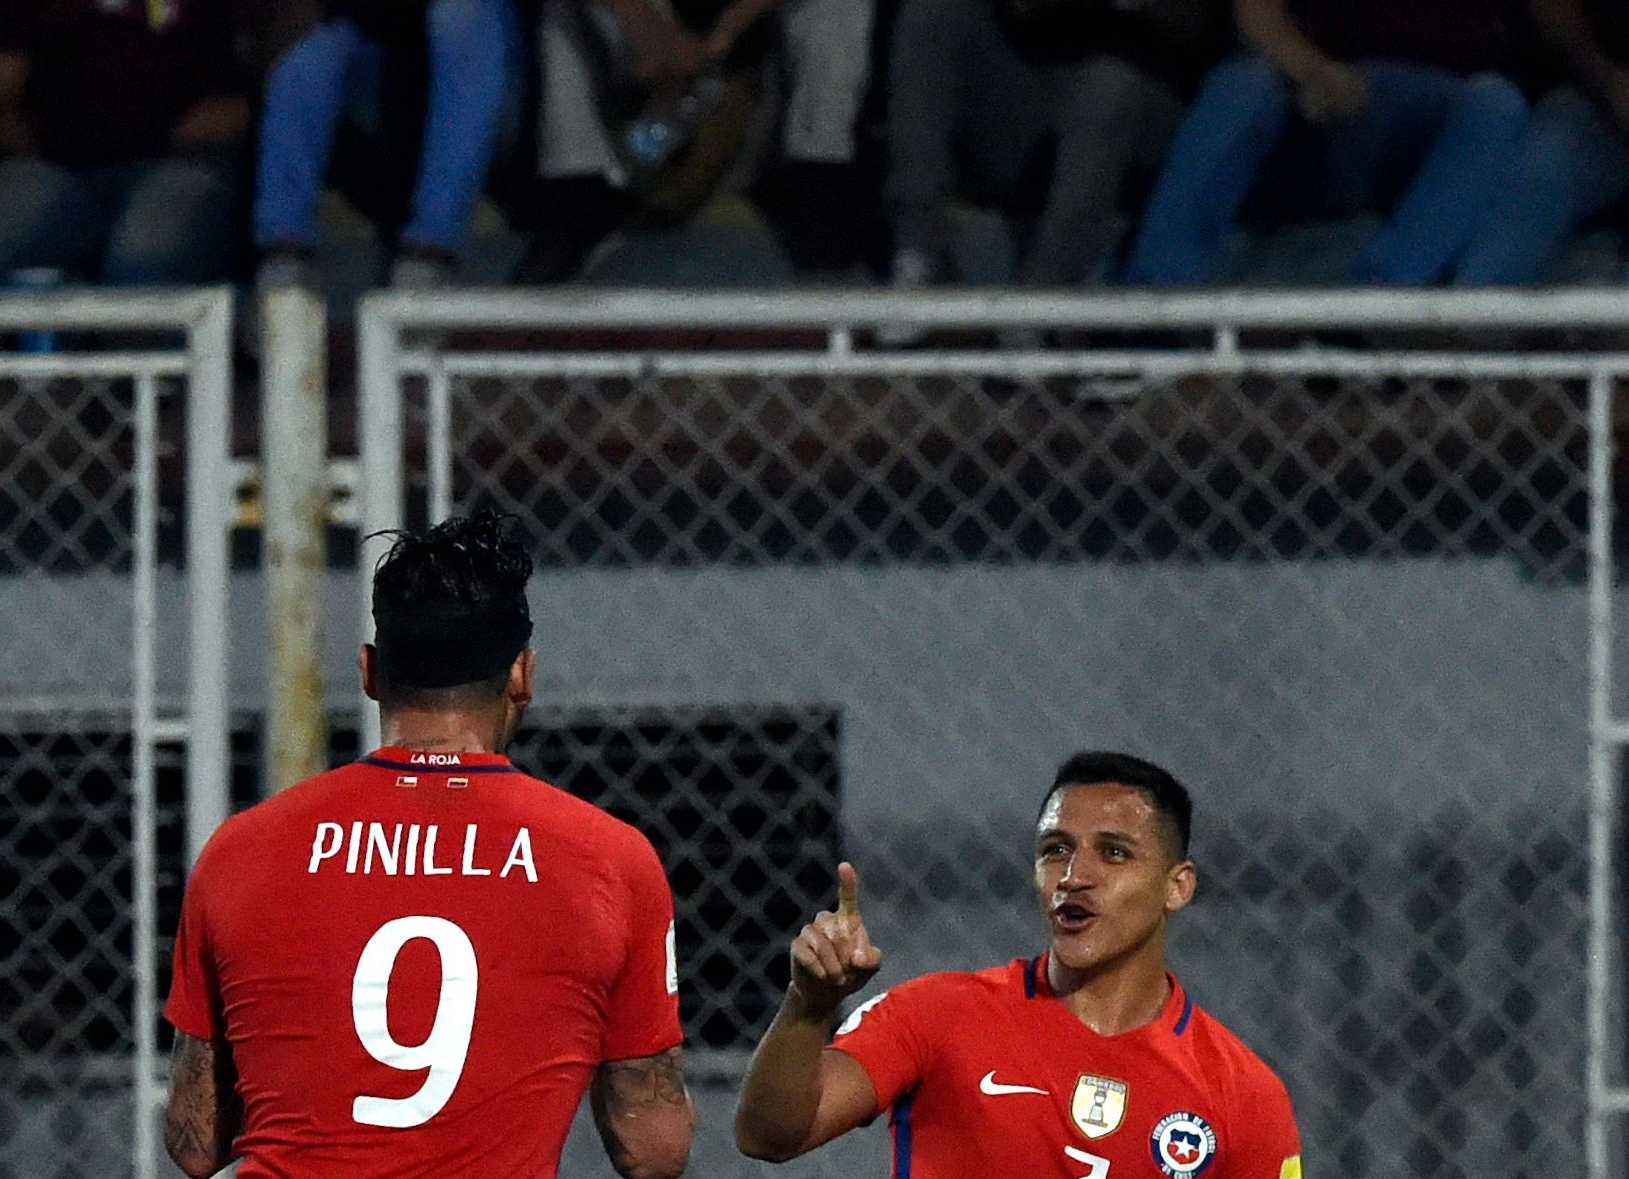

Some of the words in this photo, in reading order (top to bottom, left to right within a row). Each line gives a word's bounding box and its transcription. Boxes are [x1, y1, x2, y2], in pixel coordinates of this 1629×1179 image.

[410, 753, 426, 765] LA
[428, 754, 461, 766] ROJA
[307, 821, 539, 883] PINILLA
[351, 915, 479, 1128] 9
